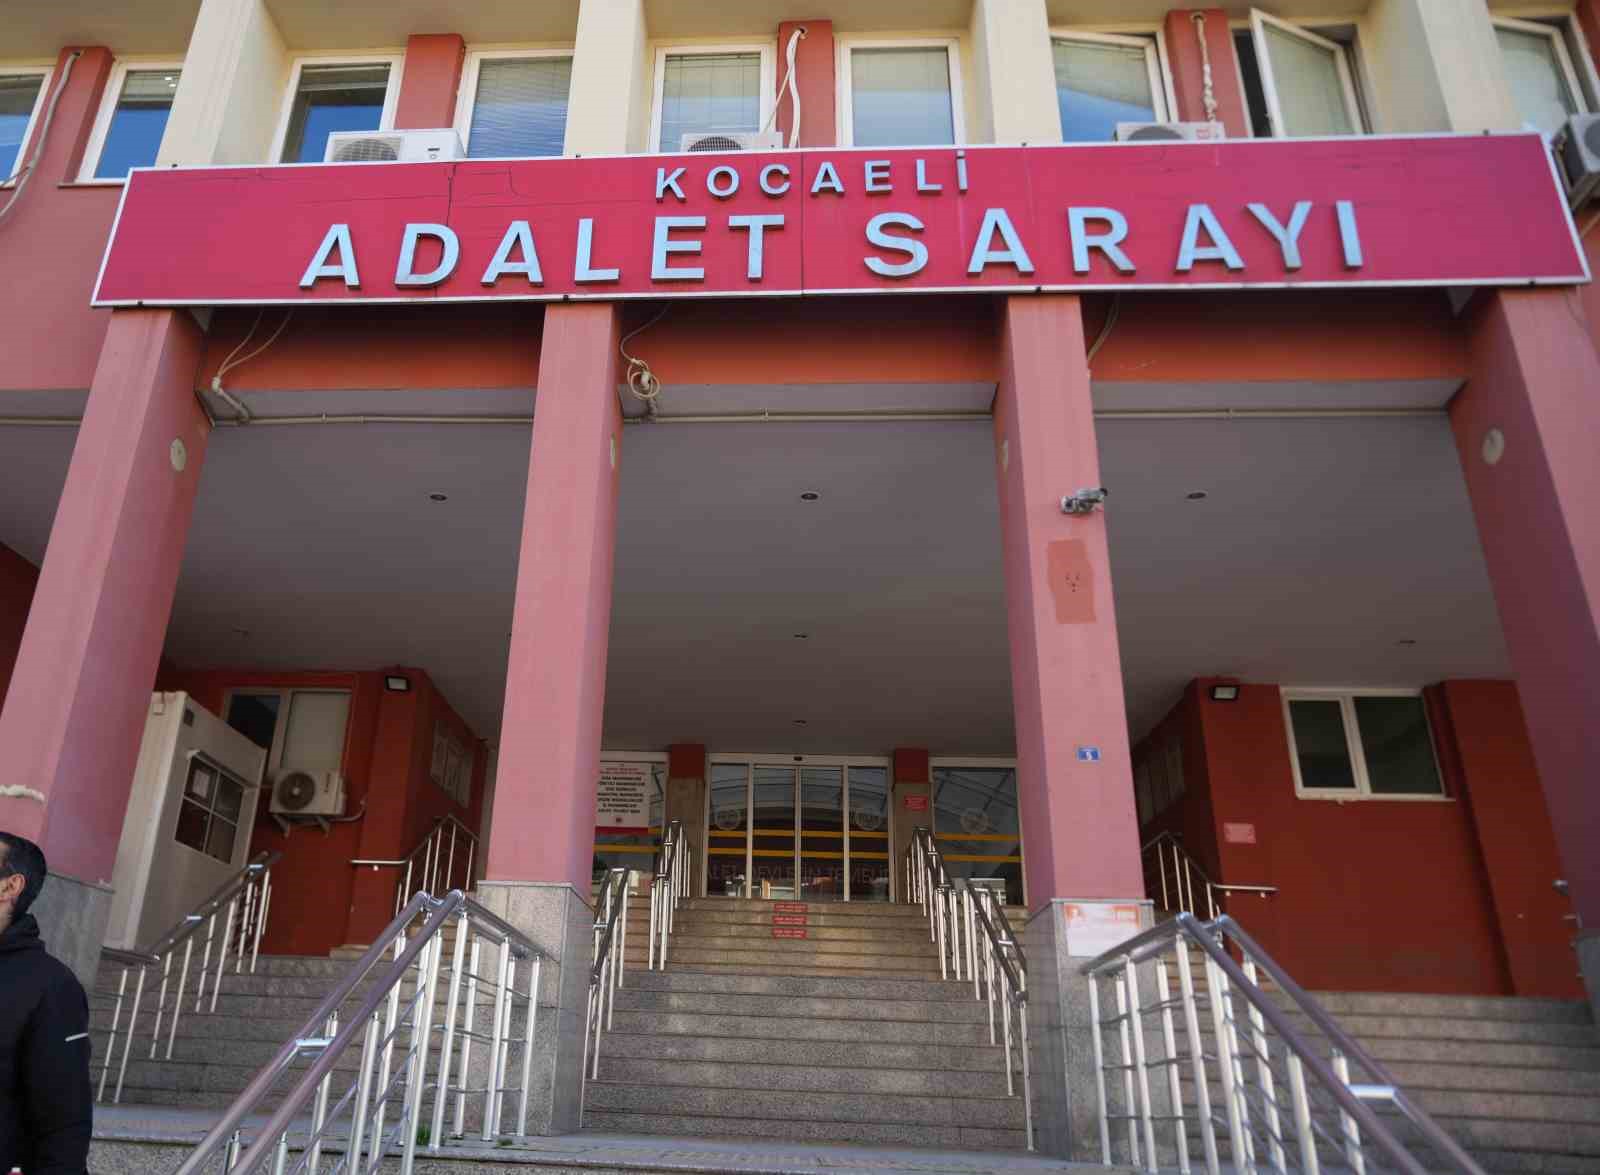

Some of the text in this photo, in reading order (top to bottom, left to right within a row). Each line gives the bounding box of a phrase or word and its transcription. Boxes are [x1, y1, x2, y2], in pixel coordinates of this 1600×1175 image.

[655, 150, 968, 200] KOCAELİ
[298, 200, 1364, 290] ADALET SARAYI
